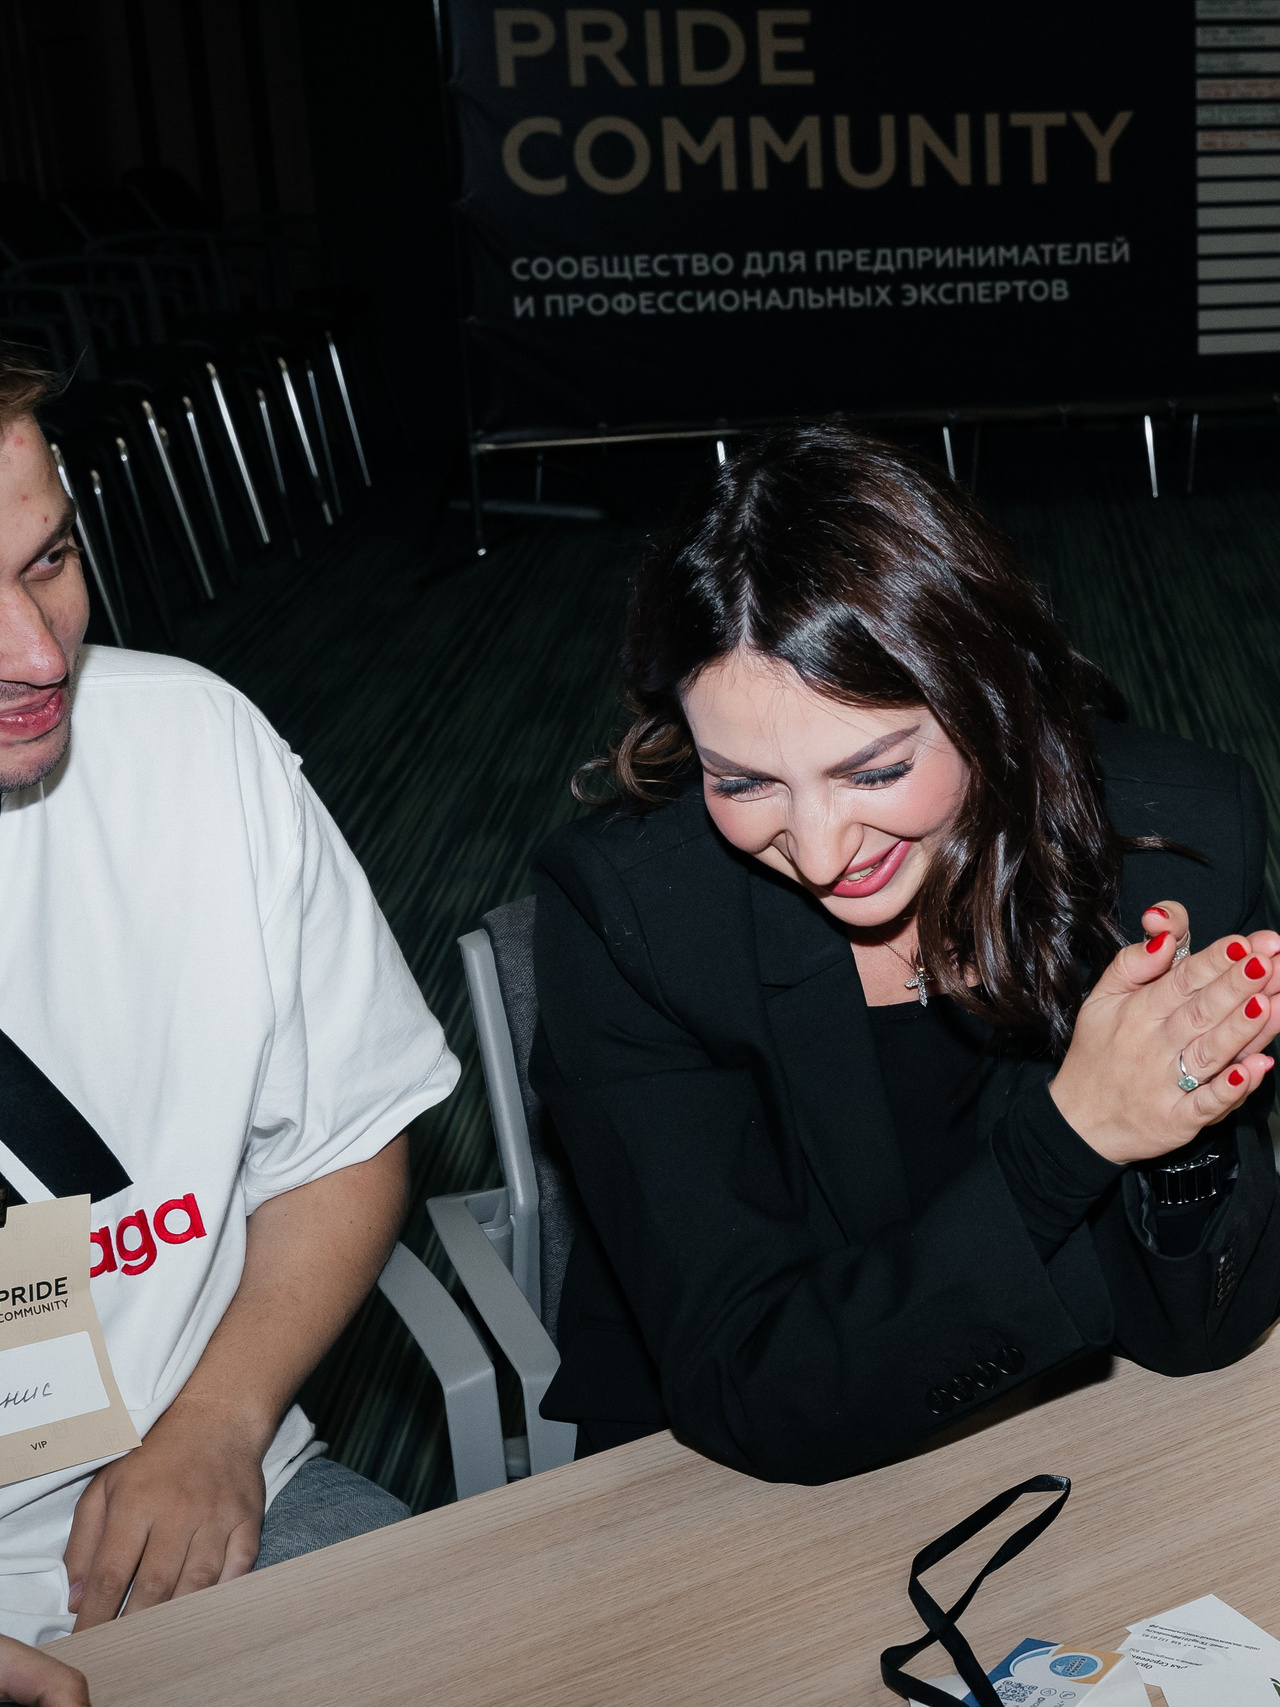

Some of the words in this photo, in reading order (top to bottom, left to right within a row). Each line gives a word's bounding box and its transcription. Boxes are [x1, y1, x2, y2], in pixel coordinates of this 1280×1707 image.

[493, 8, 815, 88] PRIDE
[501, 110, 1134, 196] COMMUNITY
[511, 252, 735, 282] СООБЩЕСТВО
[742, 250, 807, 279] ДЛЯ
[815, 236, 1131, 275] ПРЕДПРИНИМАТЕЛЕЙ
[513, 295, 537, 319] И
[544, 284, 894, 318] ПРОФЕССИОНАЛЬНЫХ
[900, 278, 1070, 307] ЭКСПЕРТОВ
[0, 1382, 53, 1408] нис
[30, 1440, 48, 1451] VIP
